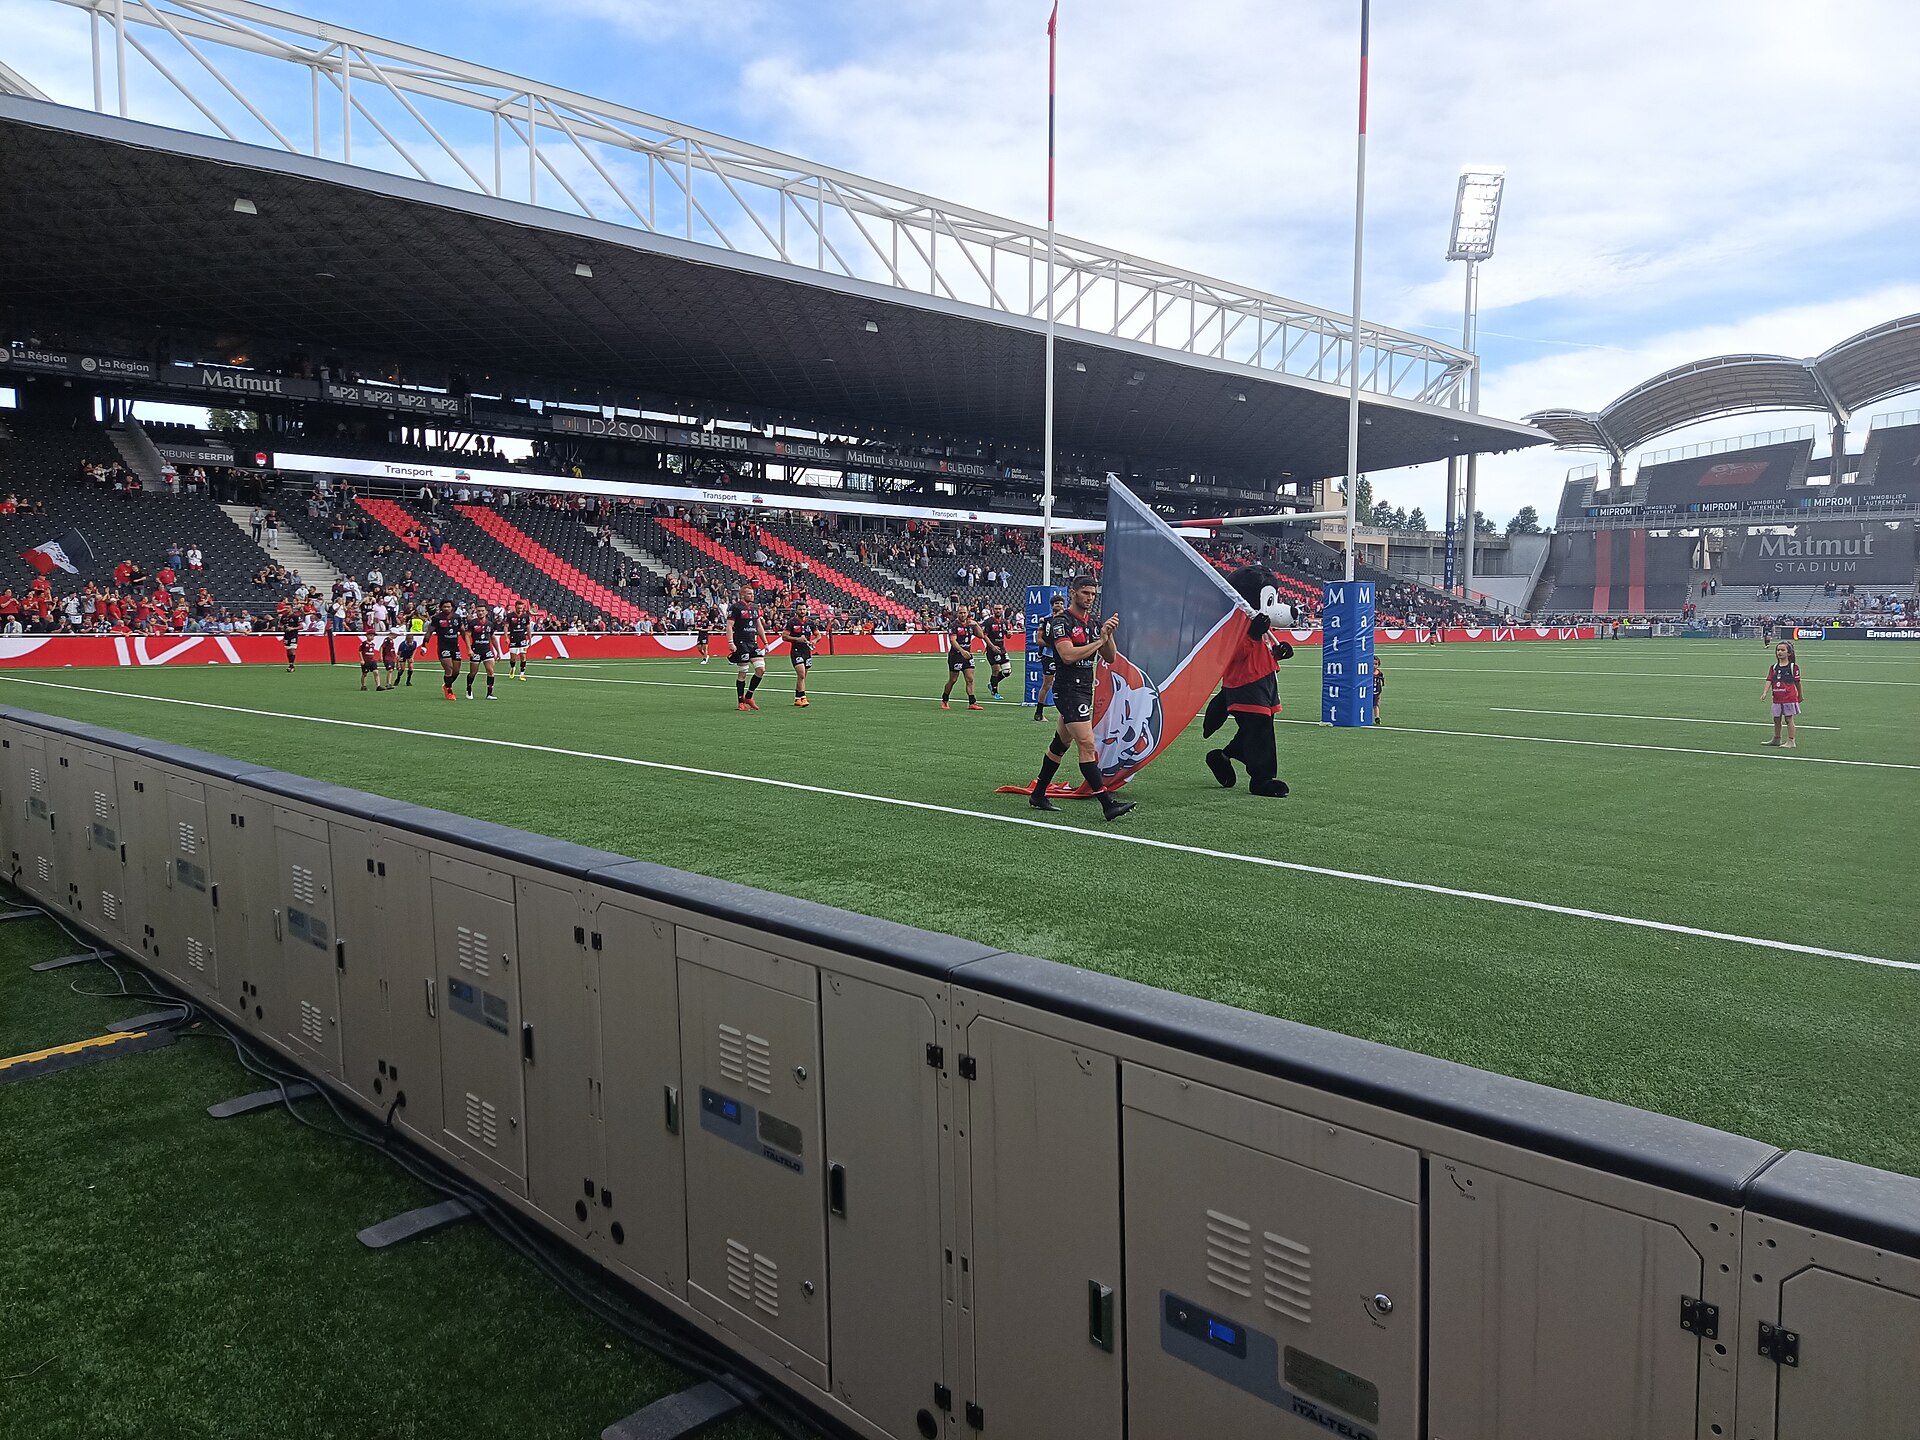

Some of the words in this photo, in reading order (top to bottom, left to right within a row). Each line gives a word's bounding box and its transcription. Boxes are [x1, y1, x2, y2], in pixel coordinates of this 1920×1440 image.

[12, 349, 26, 359] La
[28, 351, 67, 364] Région
[99, 358, 111, 368] La
[114, 360, 150, 372] Région
[202, 369, 283, 393] Matmut
[690, 431, 748, 450] SERFIM
[198, 451, 234, 462] SERFIM
[784, 443, 797, 455] GL
[798, 444, 831, 458] EVENTS
[847, 450, 885, 465] Matmut
[888, 458, 925, 470] STADIUM
[385, 465, 434, 477] Transport
[947, 462, 958, 472] GL
[958, 463, 985, 475] EVENTS
[702, 491, 737, 501] Transport
[1813, 497, 1852, 507] MIPROM
[931, 509, 958, 518] Transport
[1600, 507, 1632, 516] MIPROM
[1702, 502, 1738, 512] MIPROM
[1758, 534, 1875, 557] Matmut
[1774, 561, 1857, 573] STADIUM
[1327, 587, 1345, 722] Matmut
[1357, 587, 1370, 723] Matmut
